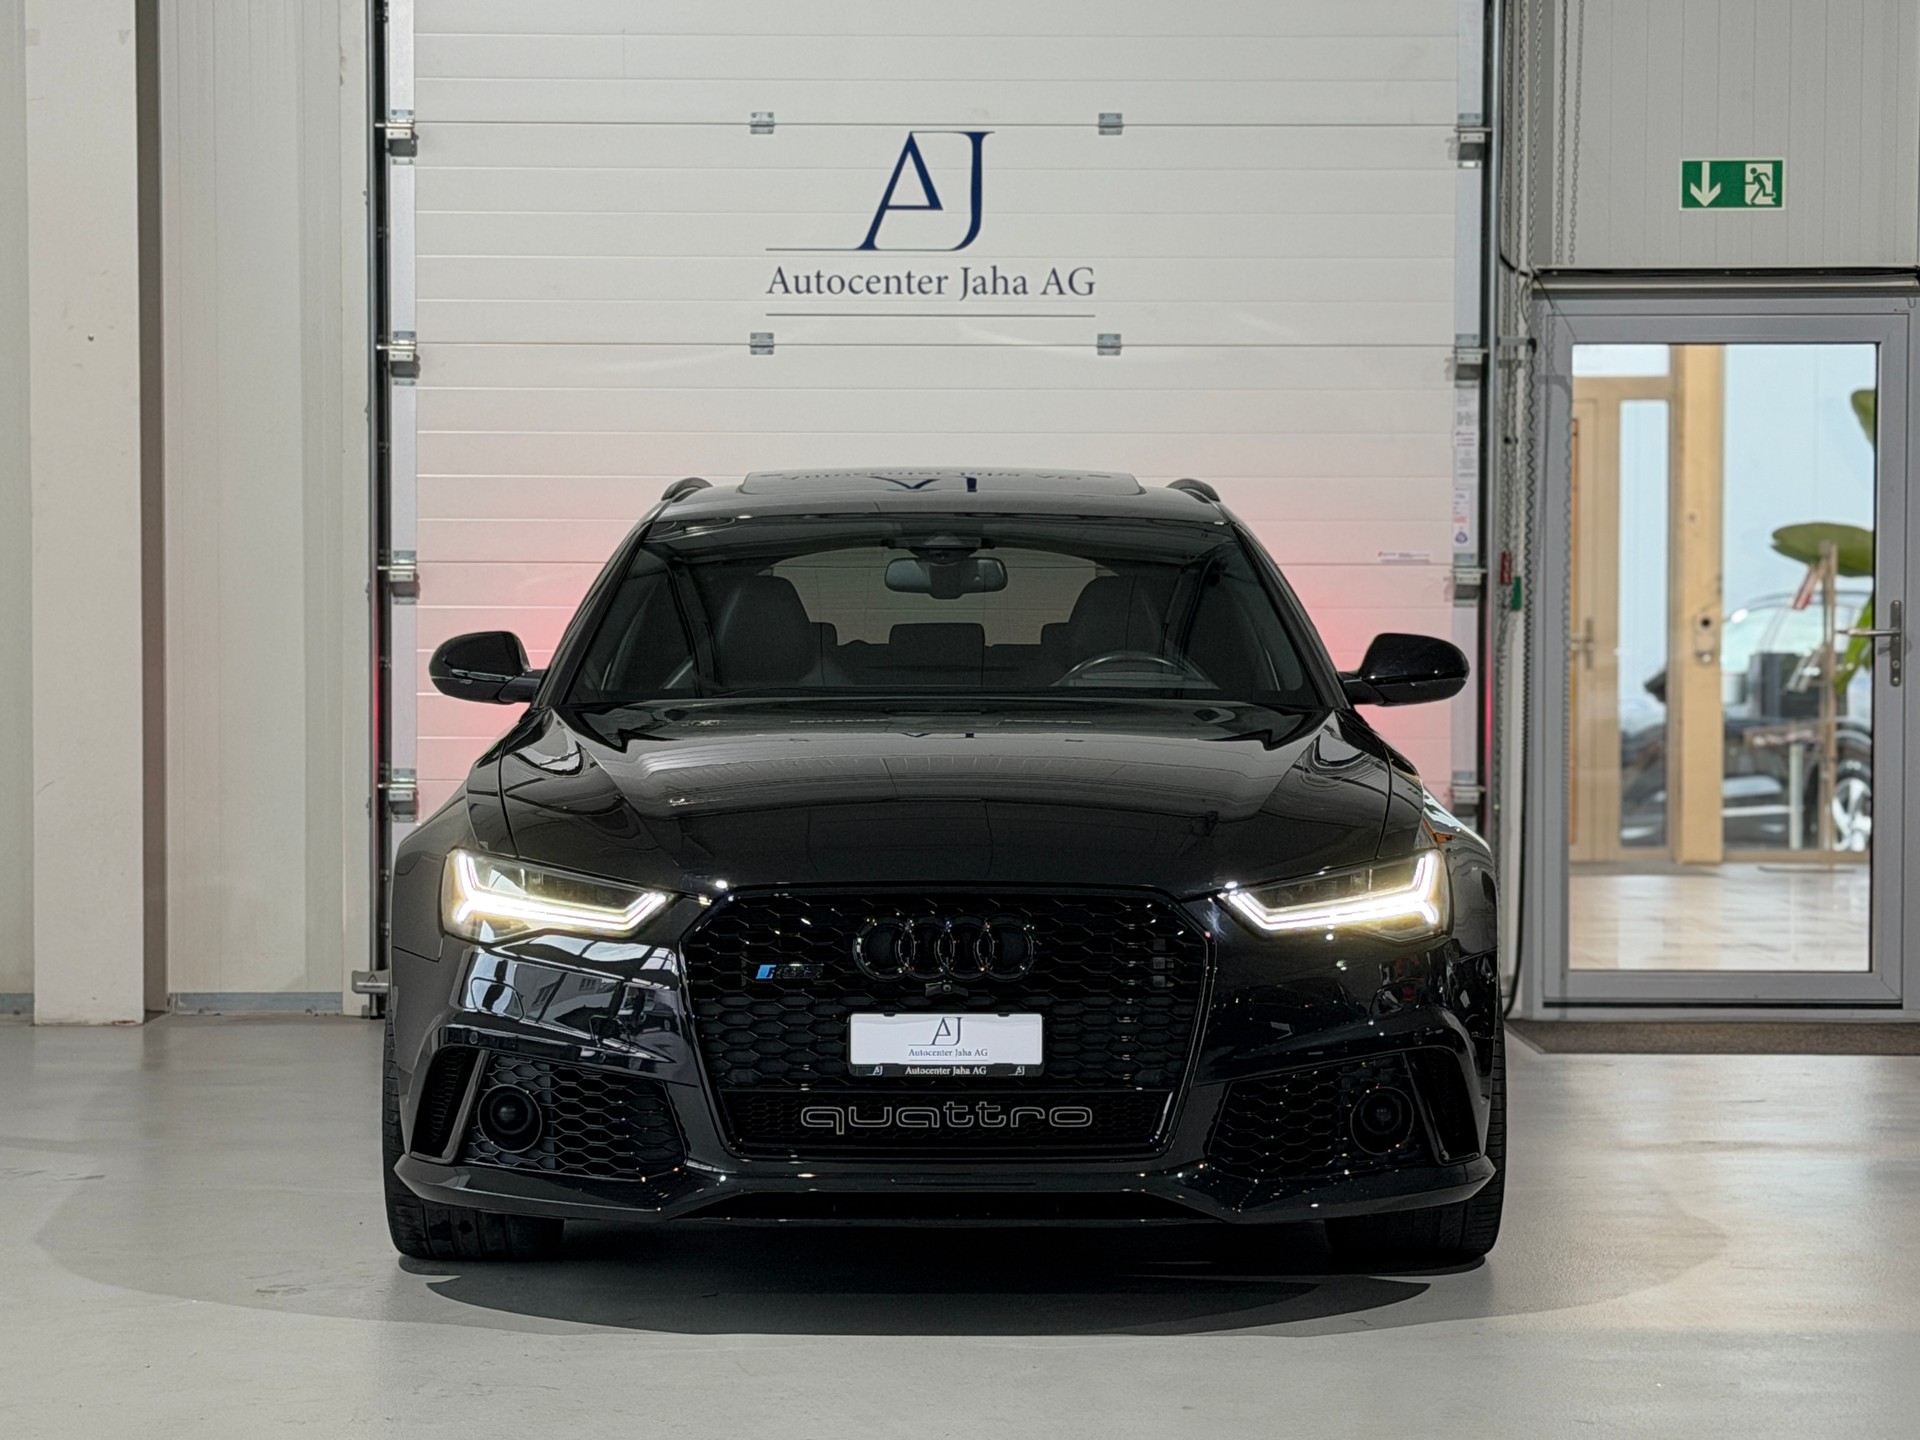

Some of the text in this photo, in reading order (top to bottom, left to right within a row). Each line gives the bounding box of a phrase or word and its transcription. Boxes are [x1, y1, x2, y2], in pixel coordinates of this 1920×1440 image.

[853, 130, 996, 252] AJ
[765, 265, 1096, 301] Autocenter Jaha AG
[930, 1016, 964, 1046] AJ
[908, 1048, 988, 1058] Autocenter Jaha AG
[905, 1066, 987, 1076] Autocenter Jaha AG
[801, 1101, 1093, 1135] quattro
